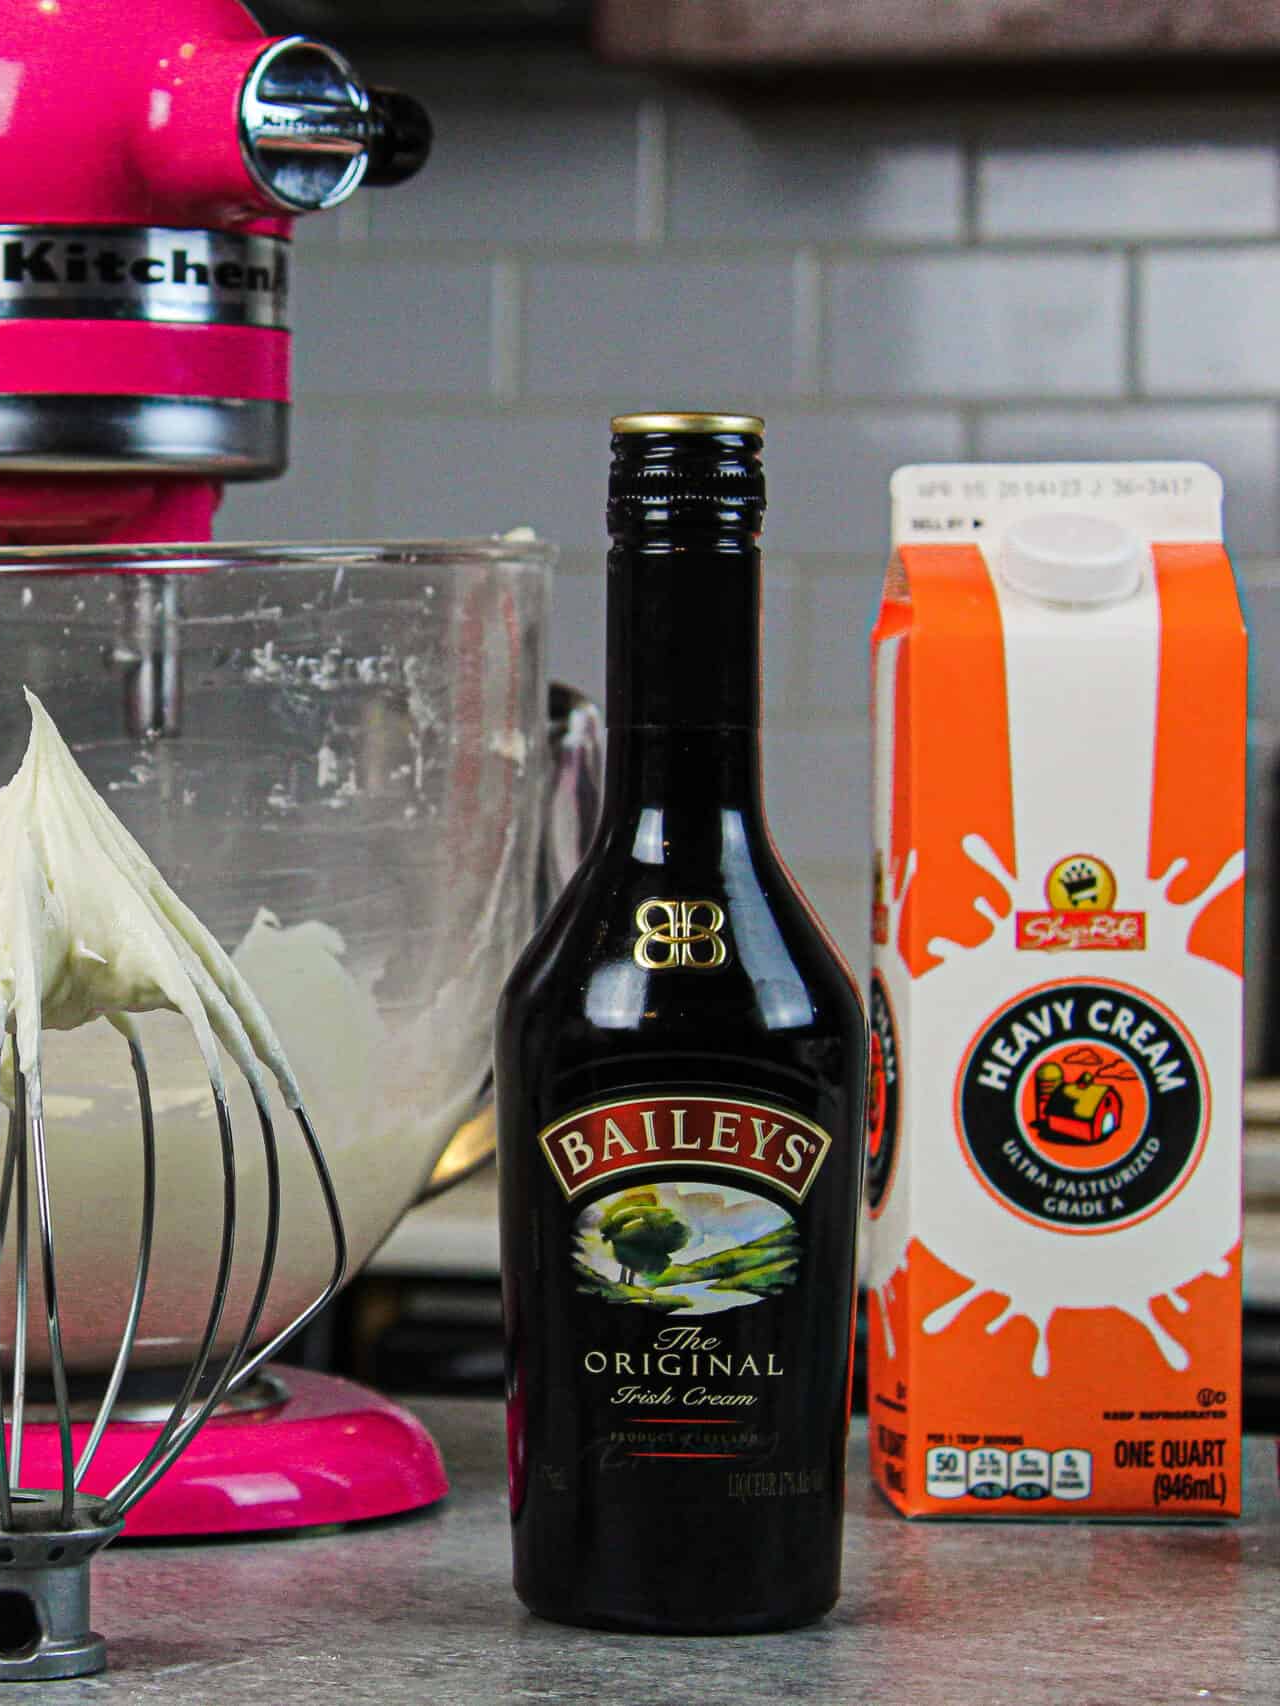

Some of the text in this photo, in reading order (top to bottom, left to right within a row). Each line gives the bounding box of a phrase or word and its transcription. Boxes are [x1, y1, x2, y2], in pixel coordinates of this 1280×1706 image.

[976, 999, 1076, 1093] HEAVY
[1087, 999, 1187, 1094] CREAM
[557, 1109, 812, 1176] BAILEYS
[1043, 1196, 1124, 1216] GRADE A
[653, 1326, 721, 1351] The
[584, 1351, 785, 1377] ORIGINAL
[610, 1386, 758, 1407] Irish Cream
[935, 1452, 958, 1472] 50
[1114, 1439, 1226, 1469] ONE QUART
[1153, 1472, 1226, 1506] (946mL)
